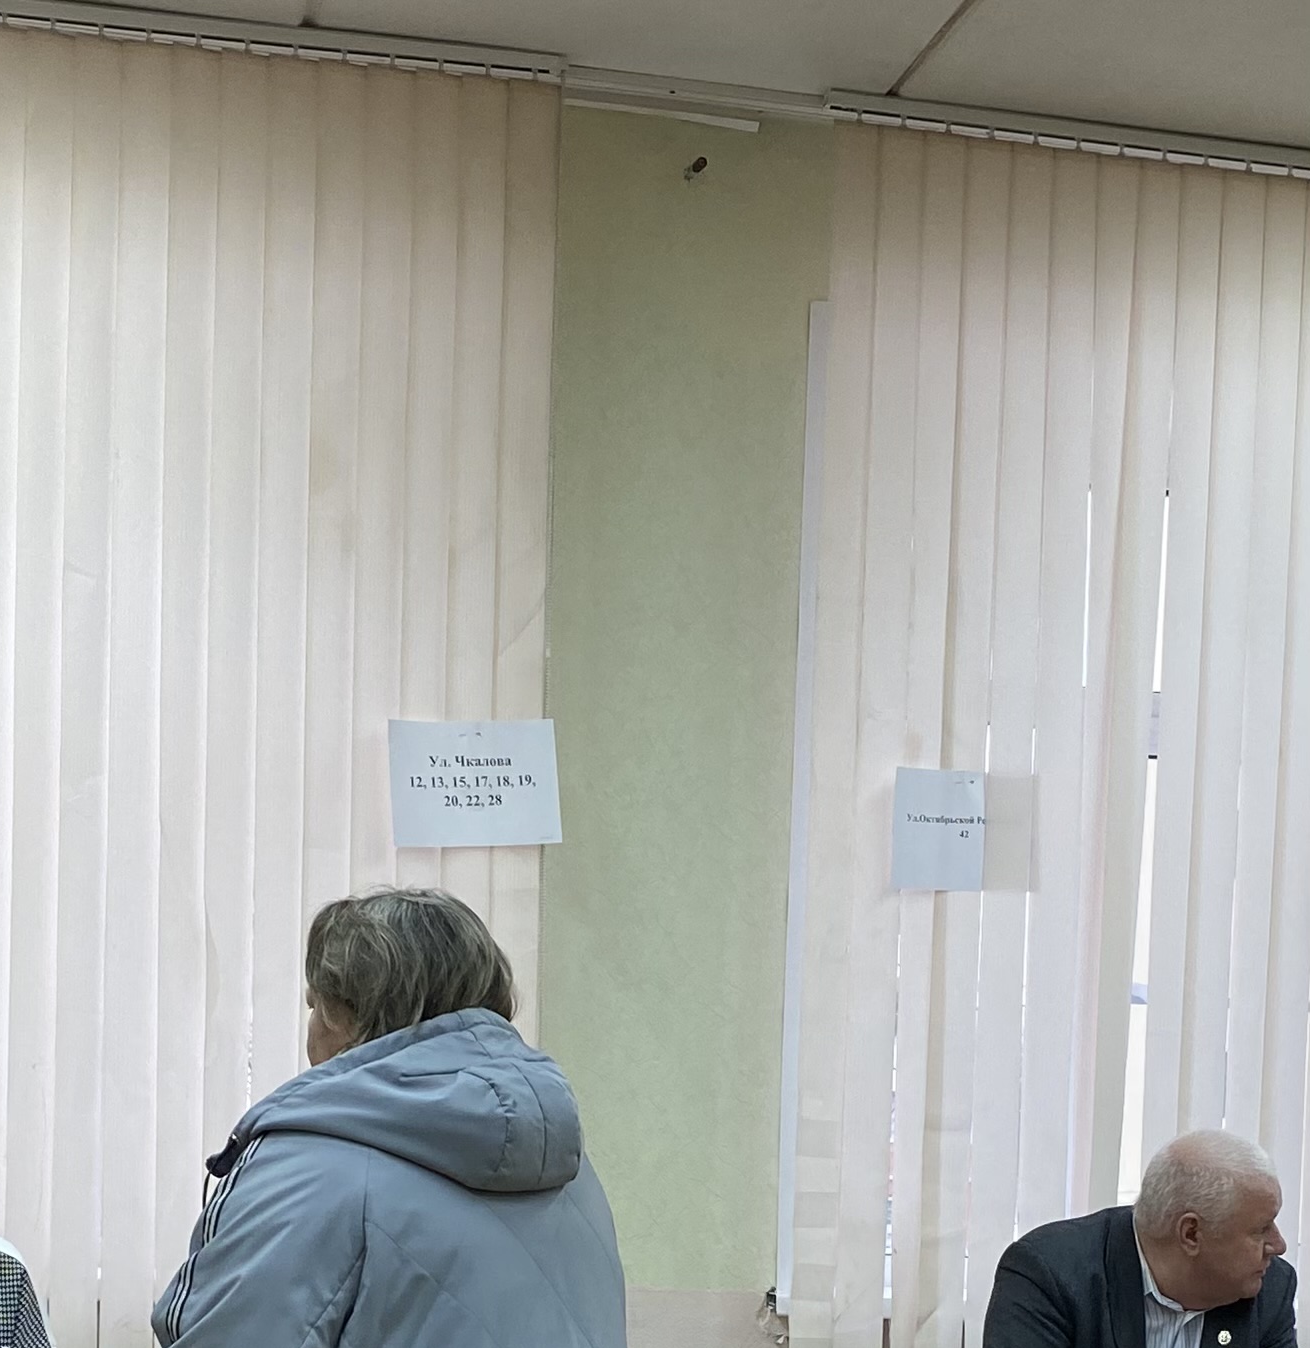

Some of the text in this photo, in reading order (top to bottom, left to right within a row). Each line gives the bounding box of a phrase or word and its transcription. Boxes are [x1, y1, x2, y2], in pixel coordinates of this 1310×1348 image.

[428, 755, 512, 768] Ул. Чкалова
[409, 774, 537, 789] 12, 13, 15, 17, 18, 19,
[443, 794, 503, 809] 20, 22, 28
[959, 830, 970, 839] 42
